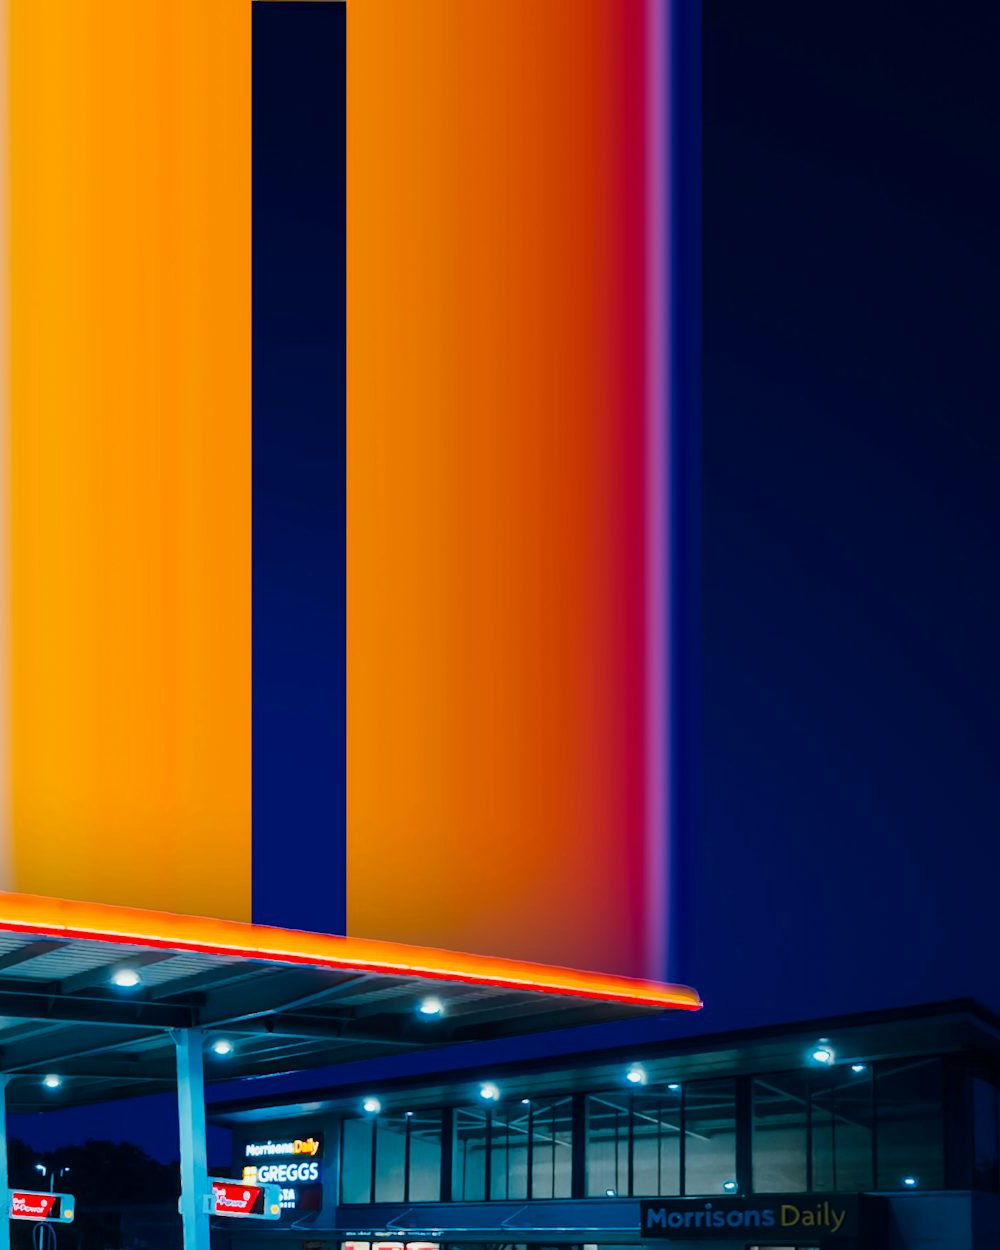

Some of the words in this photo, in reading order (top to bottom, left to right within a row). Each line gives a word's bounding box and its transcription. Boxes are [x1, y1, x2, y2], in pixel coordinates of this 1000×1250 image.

[258, 1162, 319, 1182] GREGGS
[645, 1202, 777, 1229] Morrisons
[779, 1200, 847, 1233] Daily
